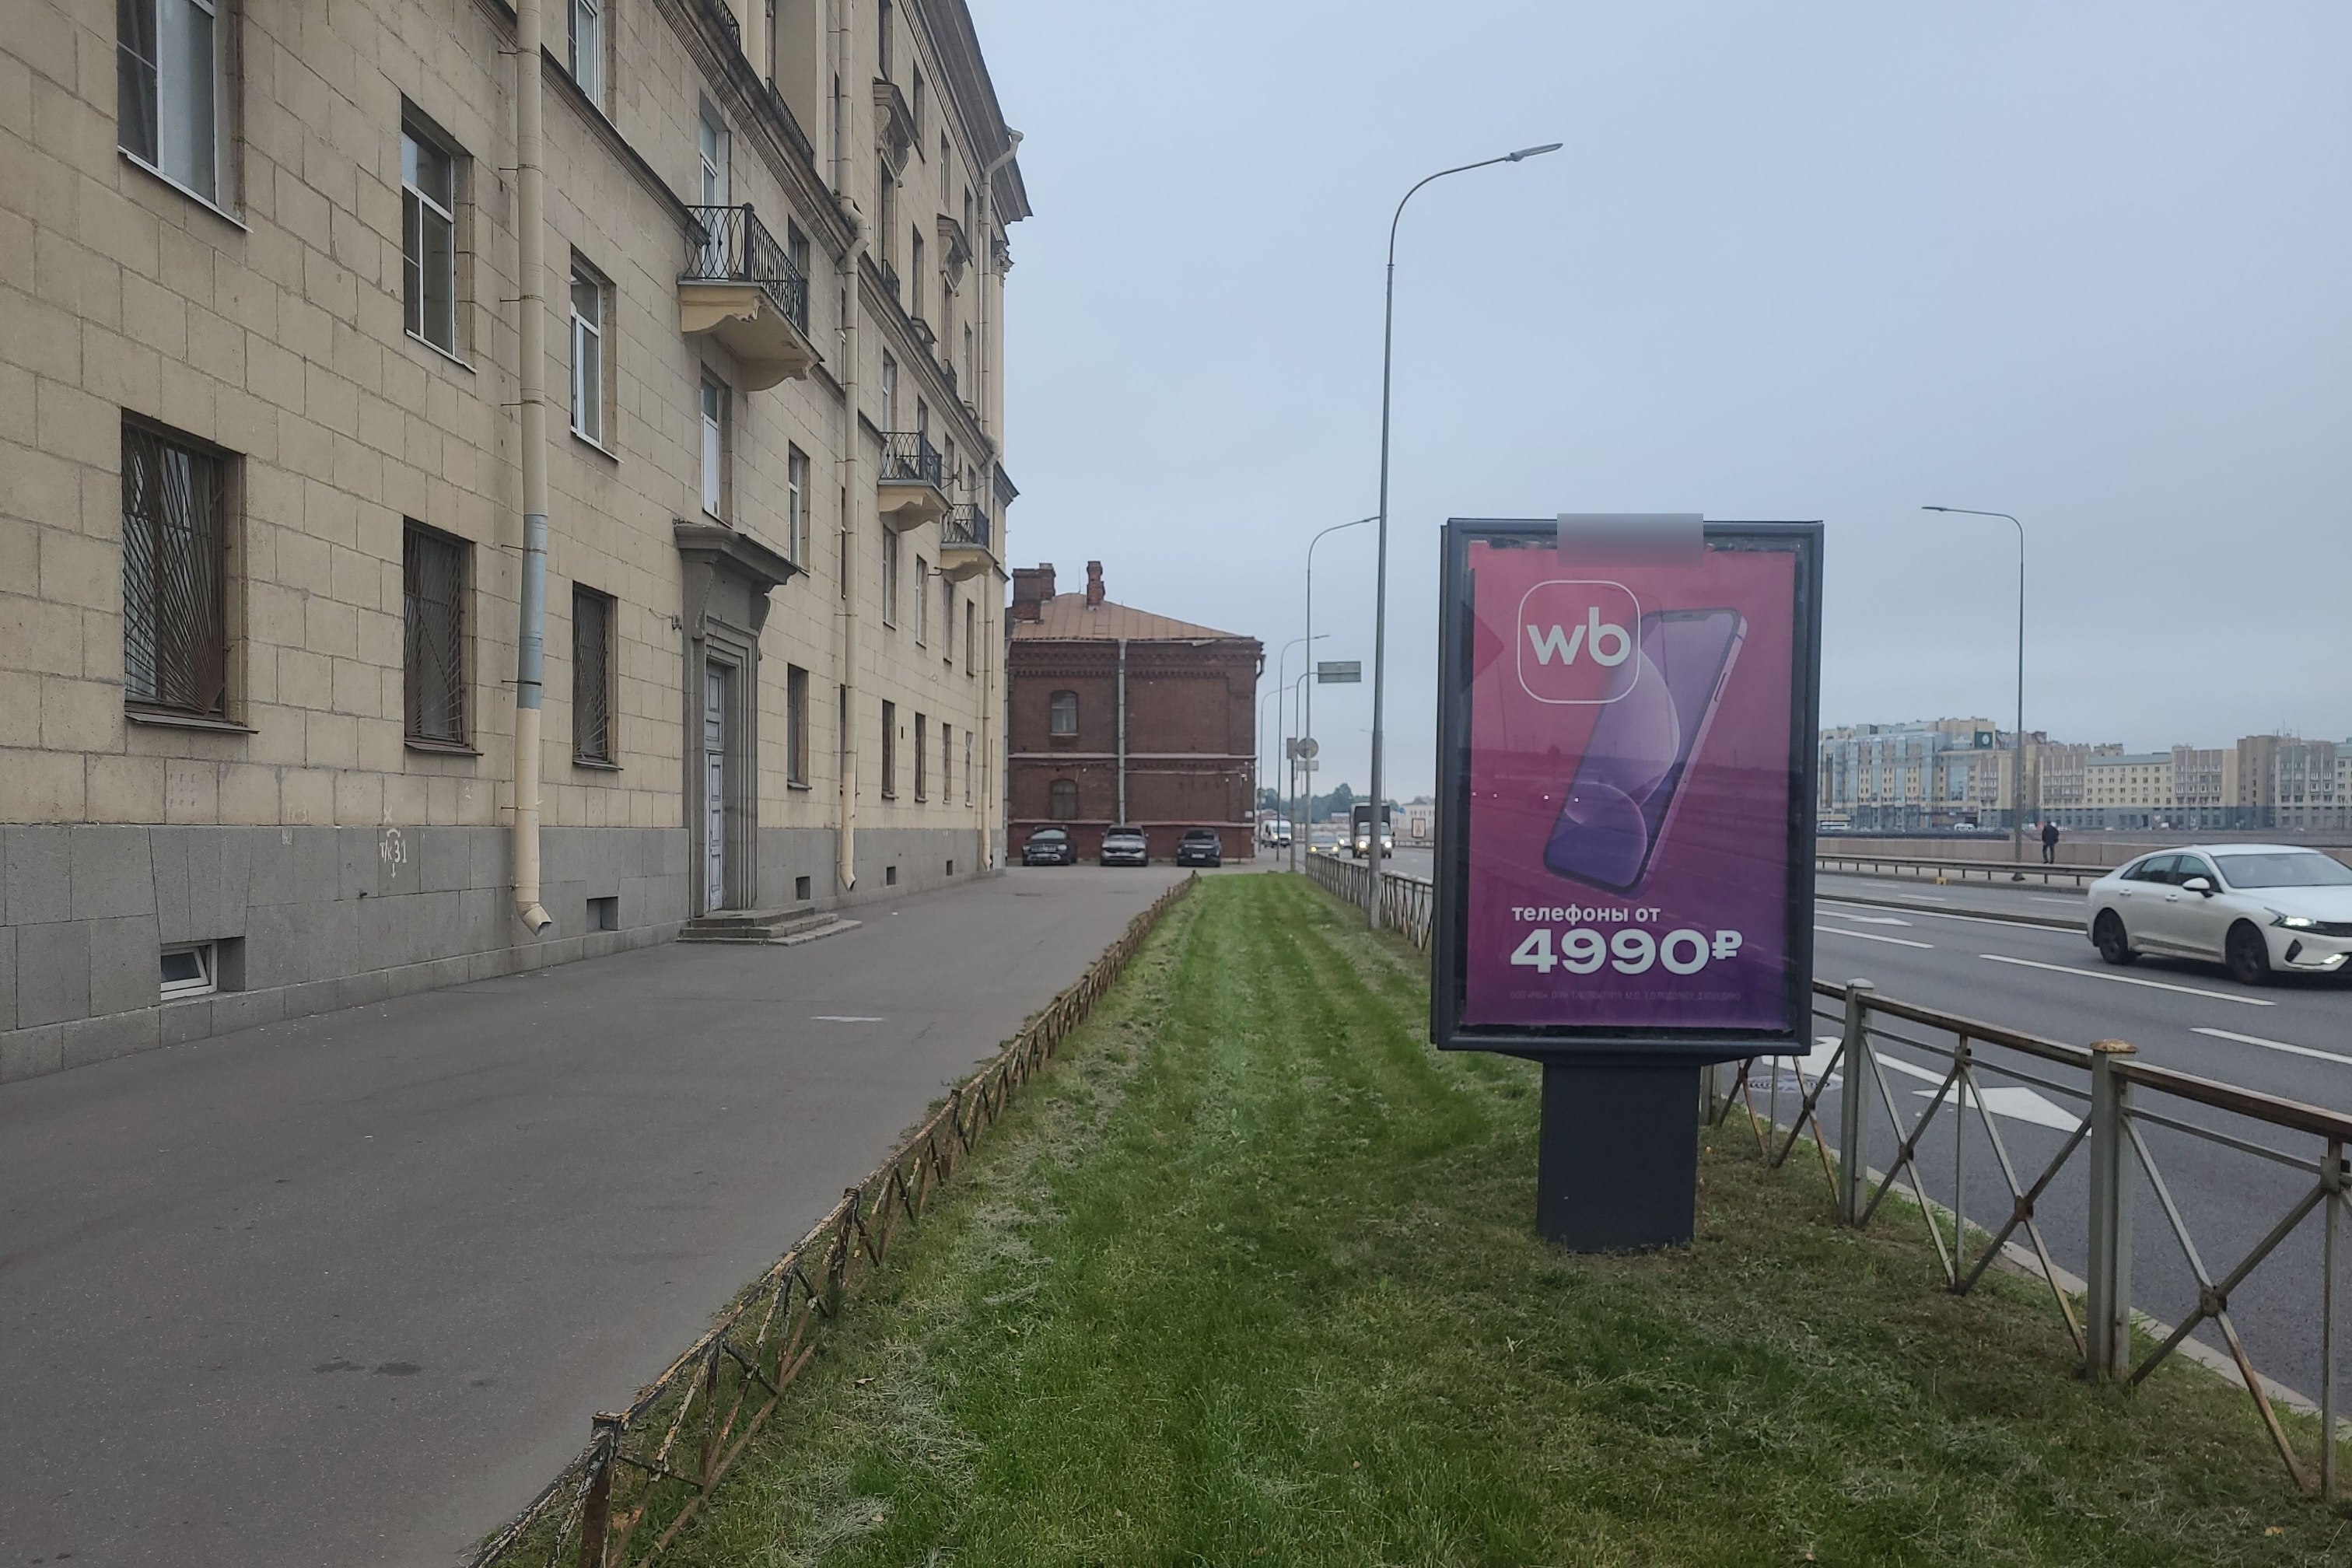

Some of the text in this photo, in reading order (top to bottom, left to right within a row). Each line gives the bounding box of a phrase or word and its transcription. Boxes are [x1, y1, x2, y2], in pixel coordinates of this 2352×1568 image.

[1526, 607, 1632, 667] wb
[1511, 904, 1661, 926] телефоны от
